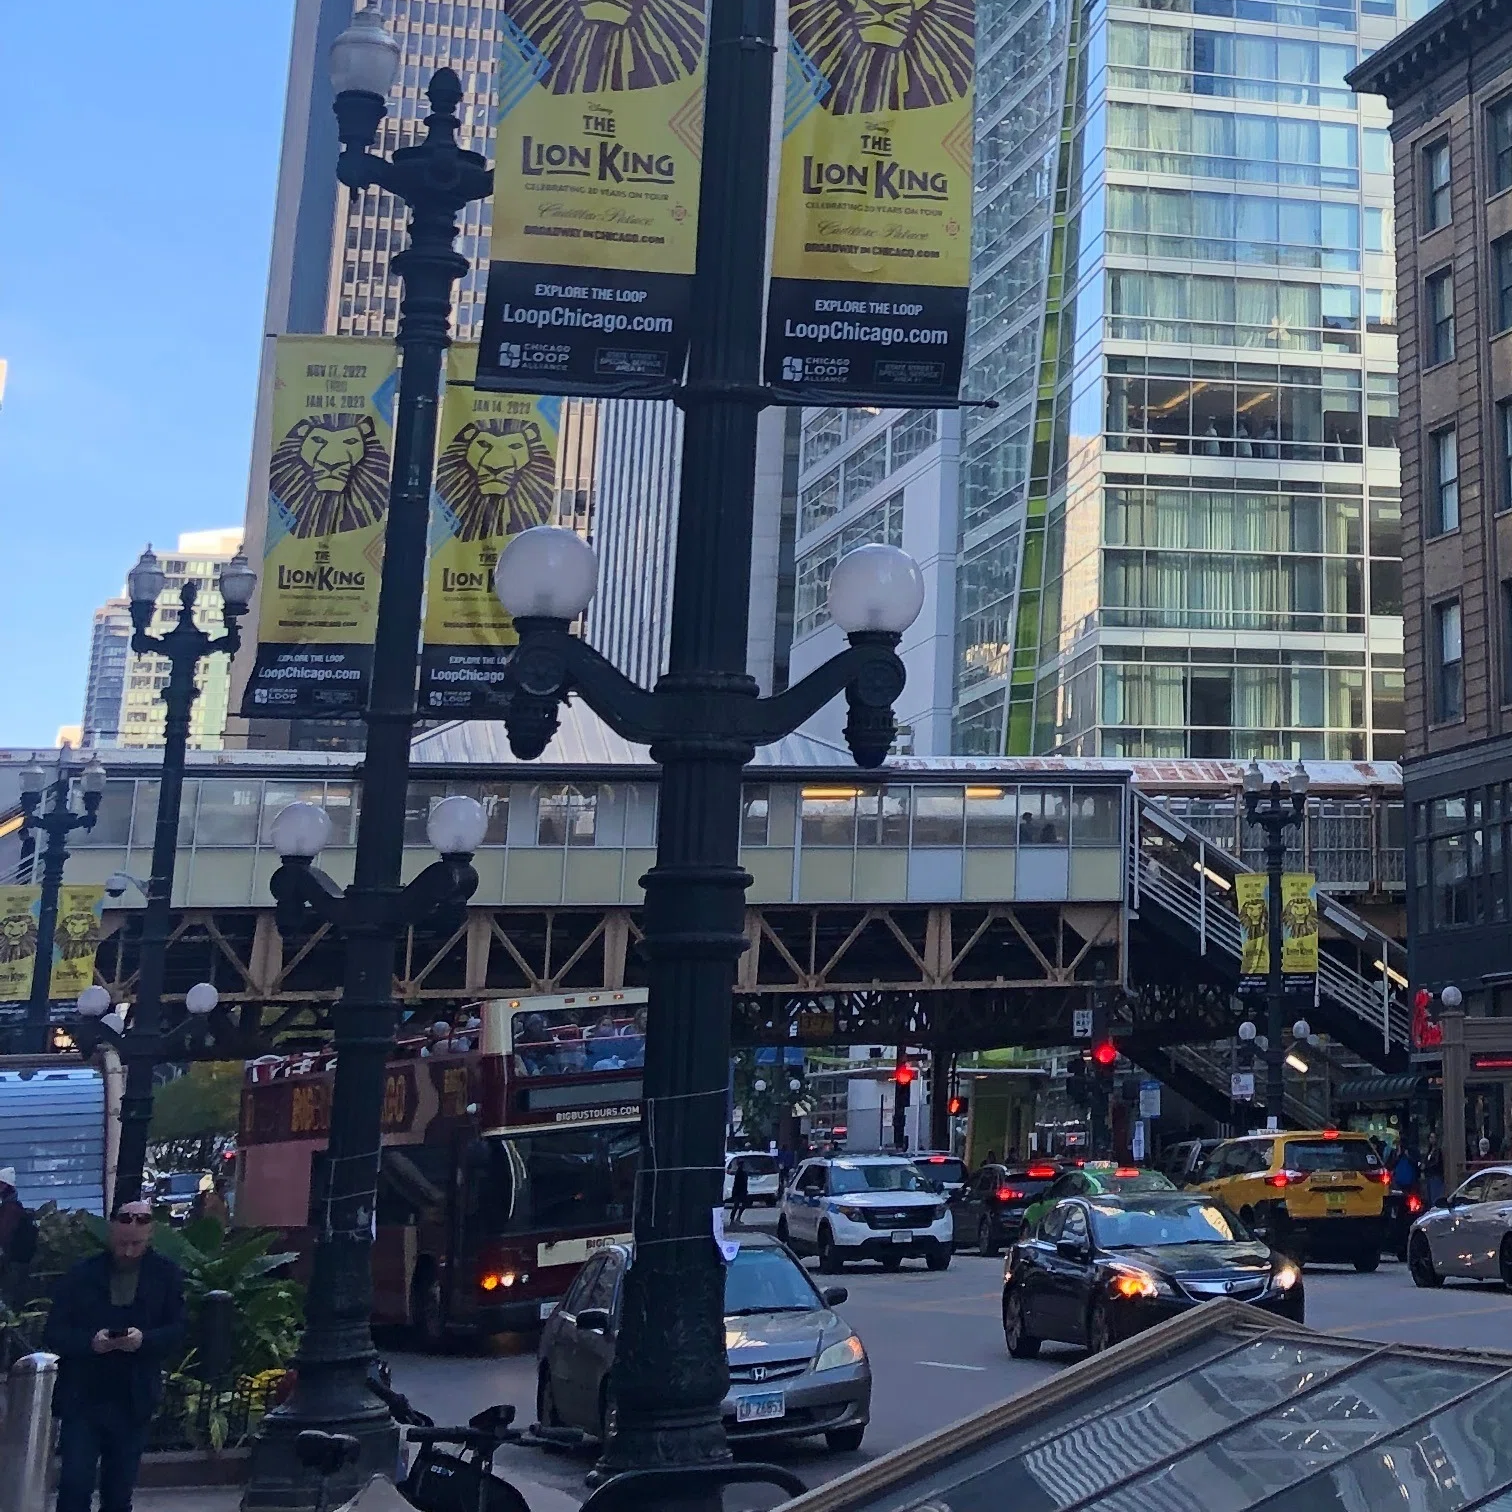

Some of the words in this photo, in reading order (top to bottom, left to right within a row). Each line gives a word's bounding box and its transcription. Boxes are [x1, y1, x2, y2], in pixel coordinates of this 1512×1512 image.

[583, 115, 616, 134] THE
[860, 135, 892, 152] THE
[534, 283, 589, 299] EXPLORE
[591, 287, 614, 301] THE
[615, 290, 648, 303] LOOP
[814, 299, 866, 314] EXPLORE
[869, 302, 890, 315] THE
[892, 303, 923, 316] LOOP
[503, 303, 673, 334] LoopChicago.com
[785, 319, 948, 346] LoopChicago.com
[523, 343, 572, 353] CHICAGO
[521, 351, 570, 363] LOOP
[805, 356, 850, 366] CHICAGO
[804, 365, 850, 376] LOOP
[449, 656, 481, 665] EXPLORE
[482, 656, 495, 665] THE
[258, 666, 361, 680] LoopChicago.com
[431, 668, 505, 684] LoopChicago
[556, 1105, 640, 1121] BIGBUSTOURS.COM
